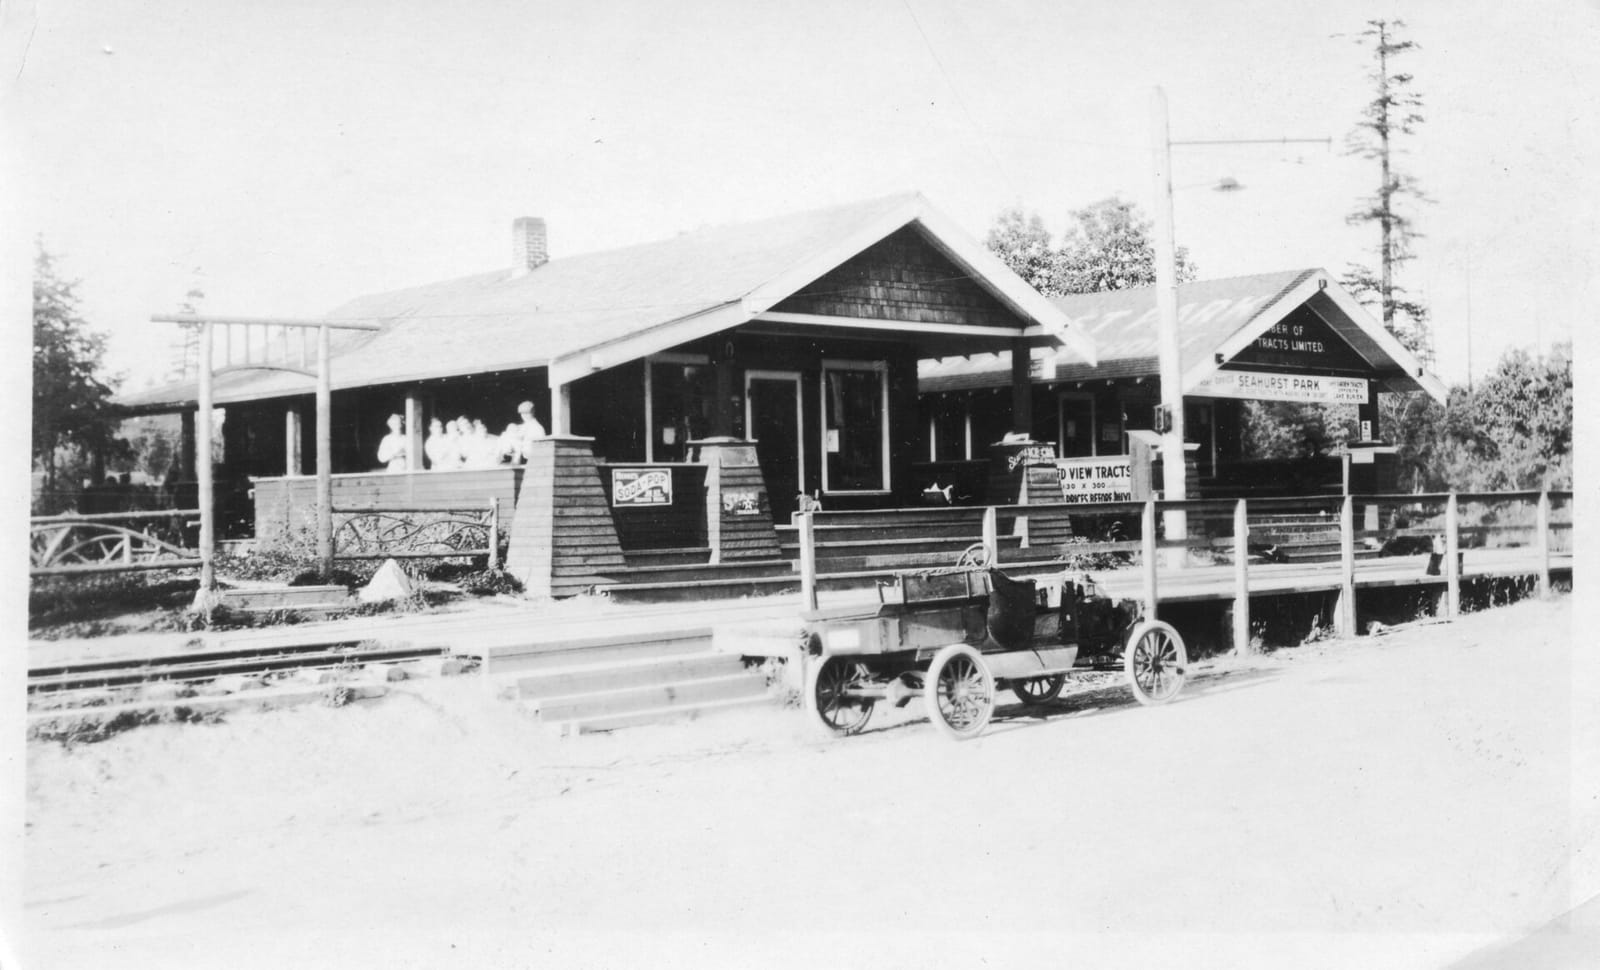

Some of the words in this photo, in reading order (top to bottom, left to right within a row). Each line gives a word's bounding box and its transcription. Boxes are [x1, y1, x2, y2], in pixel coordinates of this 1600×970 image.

[1293, 325, 1303, 336] OF
[1258, 337, 1289, 350] TRACTS
[1239, 375, 1289, 389] SEAHURST
[1293, 379, 1321, 390] PARK
[1069, 466, 1093, 480] VIEW
[1095, 465, 1131, 479] TRACTS
